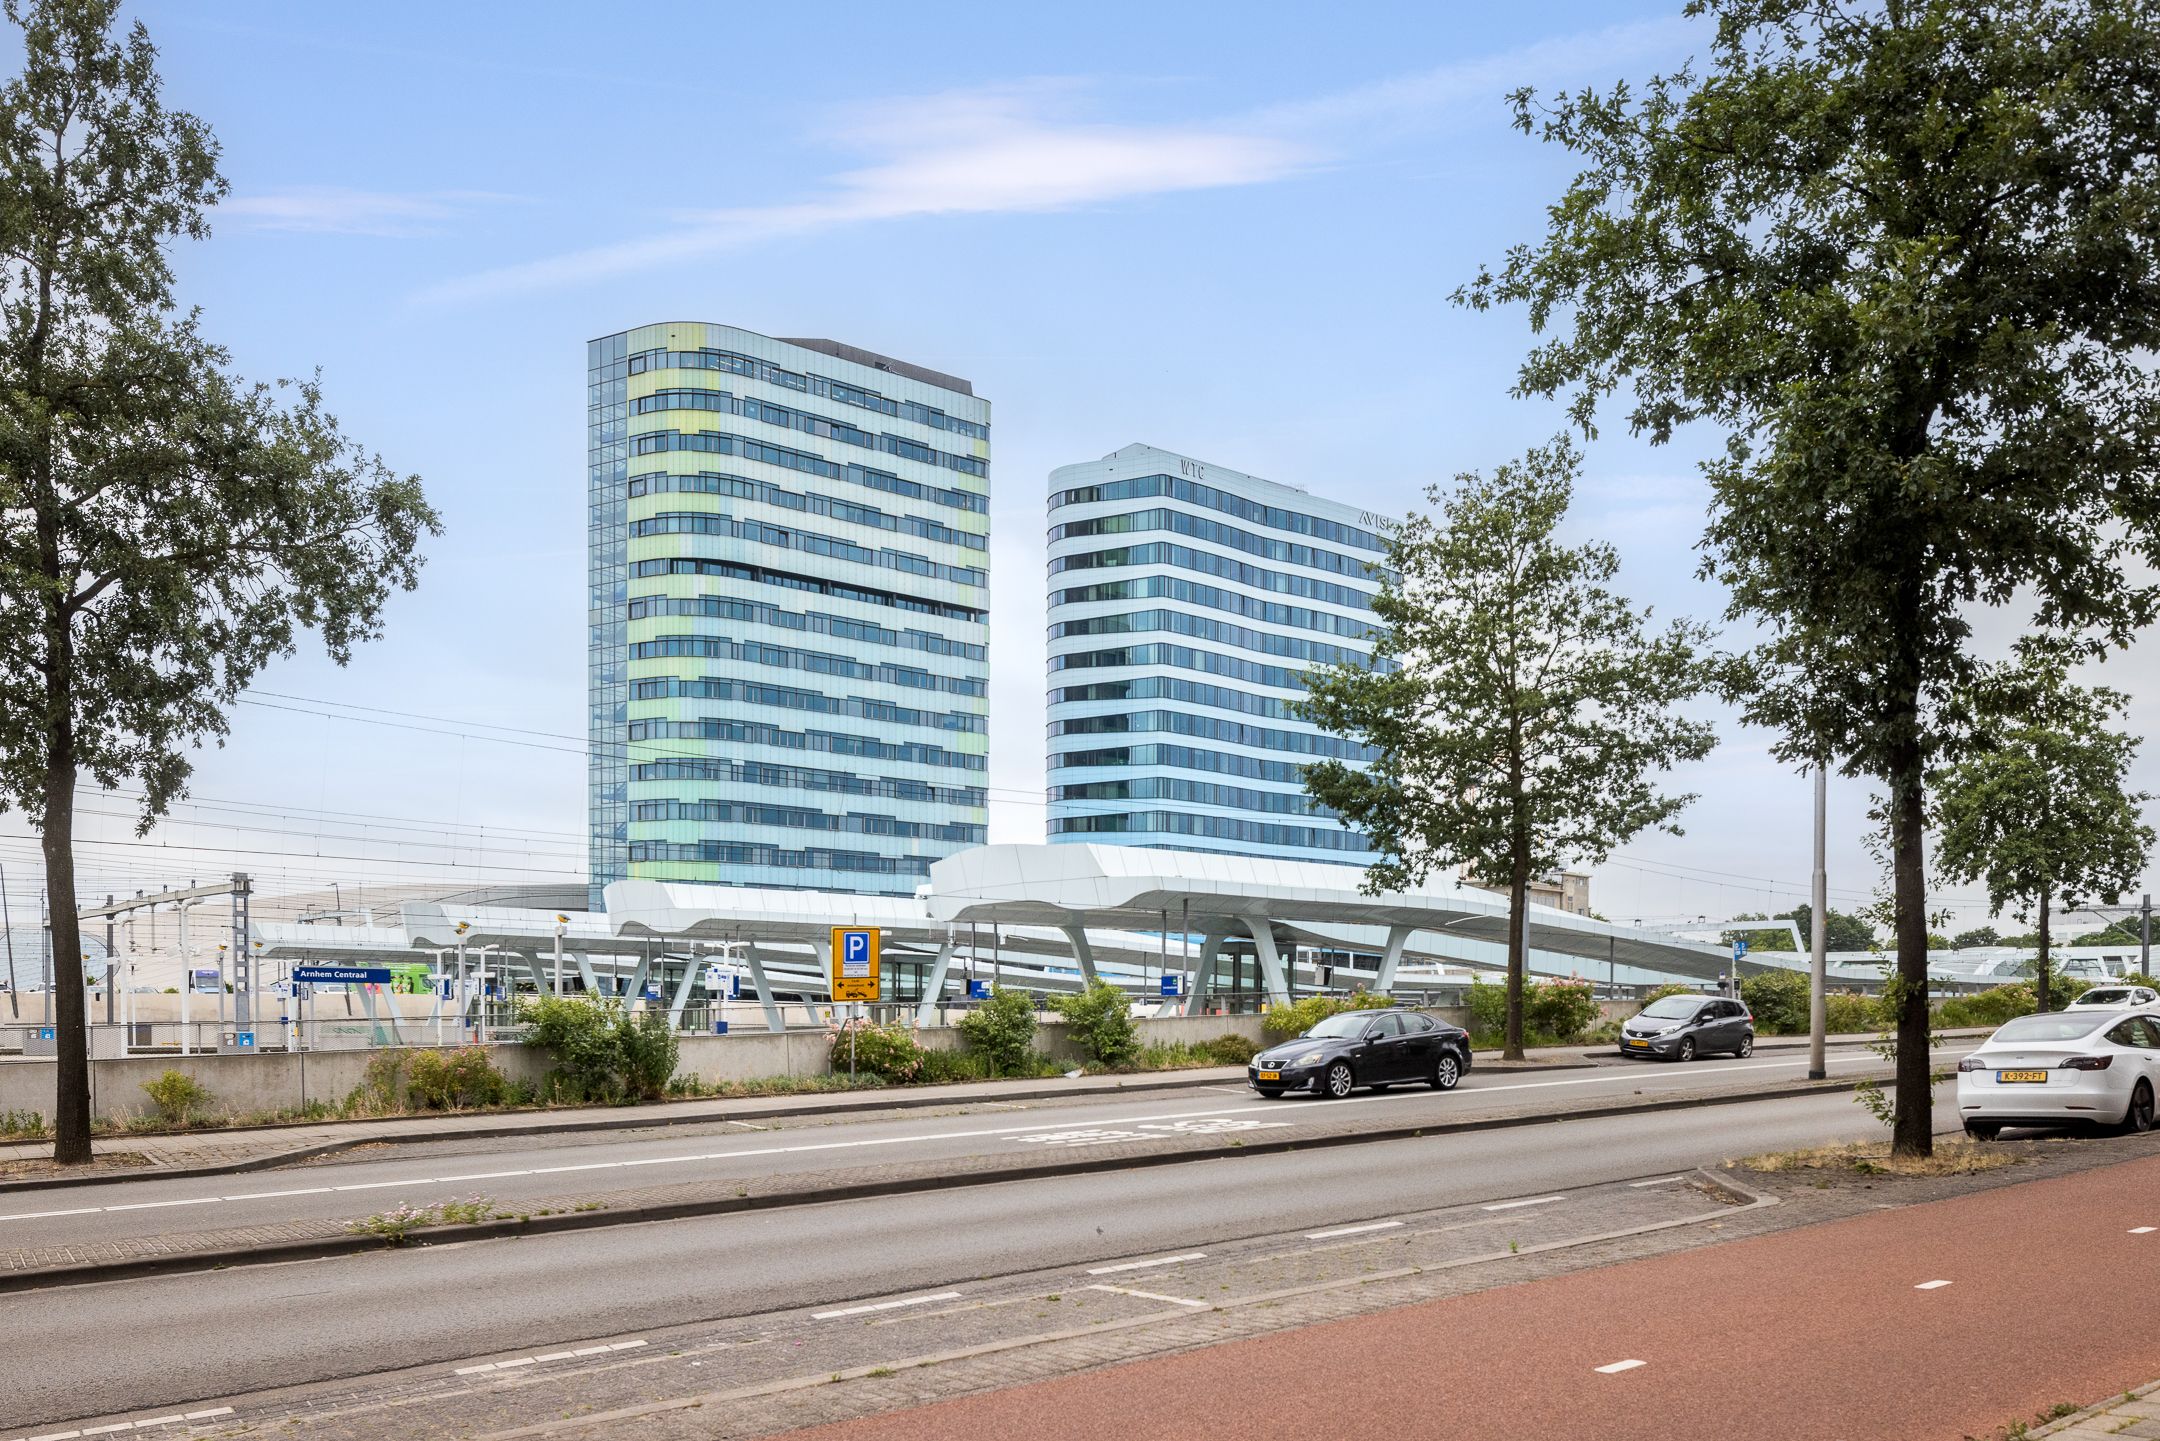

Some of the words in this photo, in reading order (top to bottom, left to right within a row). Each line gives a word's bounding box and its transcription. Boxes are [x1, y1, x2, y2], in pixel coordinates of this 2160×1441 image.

[1181, 459, 1204, 479] WTC
[850, 936, 864, 960] P
[300, 970, 332, 978] Arnhem
[334, 971, 367, 979] Centraal
[2004, 1072, 2043, 1080] K-392-FT
